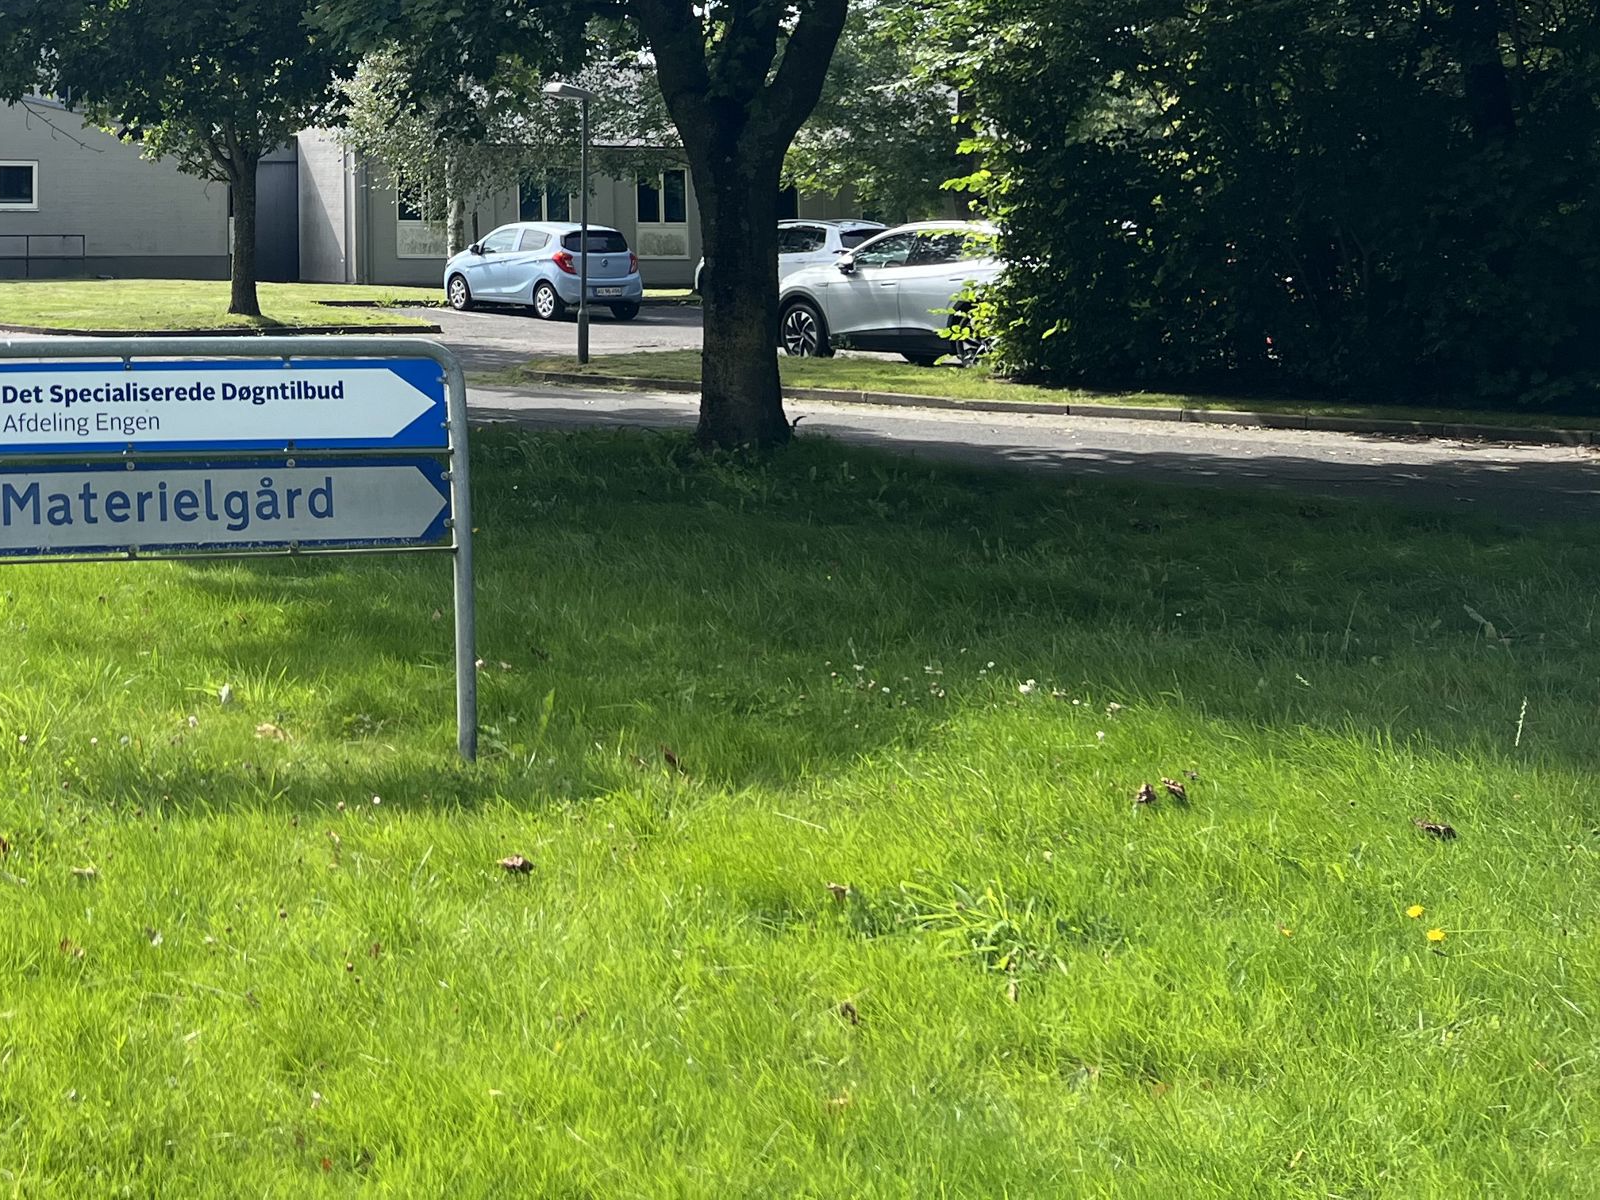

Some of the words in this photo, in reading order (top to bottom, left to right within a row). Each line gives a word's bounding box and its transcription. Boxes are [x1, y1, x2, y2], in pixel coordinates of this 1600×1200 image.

[2, 385, 43, 404] Det
[49, 382, 216, 407] Specialiserede
[221, 380, 344, 405] Døgntilbud
[3, 412, 90, 436] Afdeling
[96, 412, 160, 436] Engen
[1, 476, 335, 532] Materielgård
